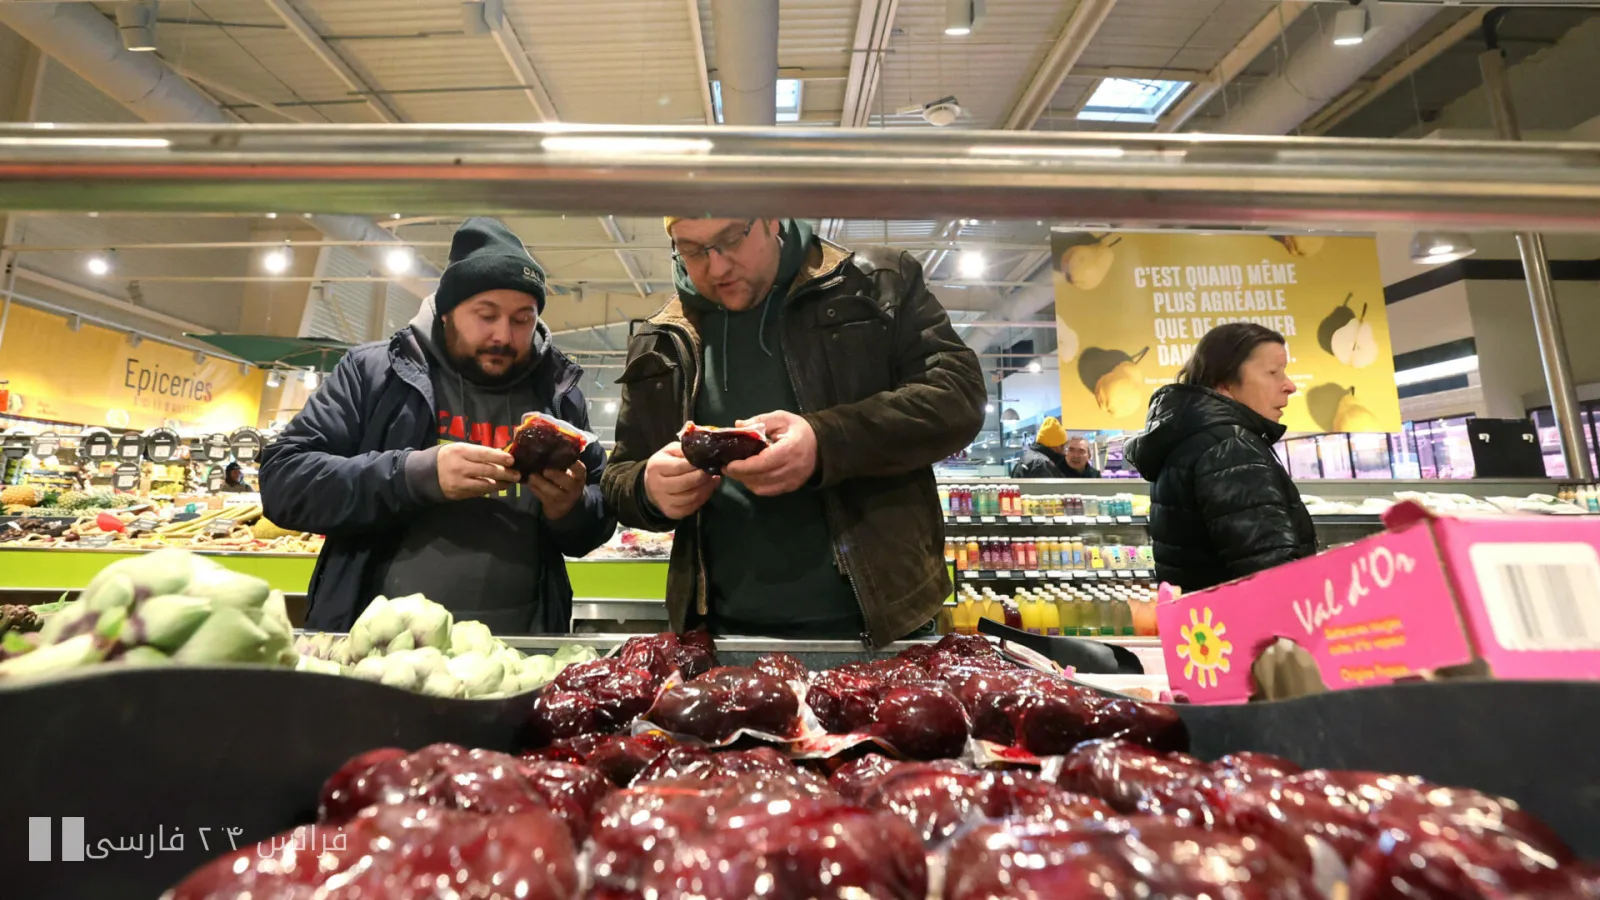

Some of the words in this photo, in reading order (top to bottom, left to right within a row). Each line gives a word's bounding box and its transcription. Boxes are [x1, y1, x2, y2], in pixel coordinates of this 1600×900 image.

[1134, 266, 1181, 288] C'EST
[1185, 265, 1243, 290] QUAND
[1247, 259, 1297, 285] MÊME
[1153, 291, 1197, 313] PLUS
[1200, 287, 1286, 312] AGRÉABLE
[1154, 317, 1189, 344] QUE
[1192, 317, 1212, 339] DE
[1157, 344, 1198, 366] DAN
[125, 358, 213, 402] Epiceries
[1292, 578, 1343, 635] Val
